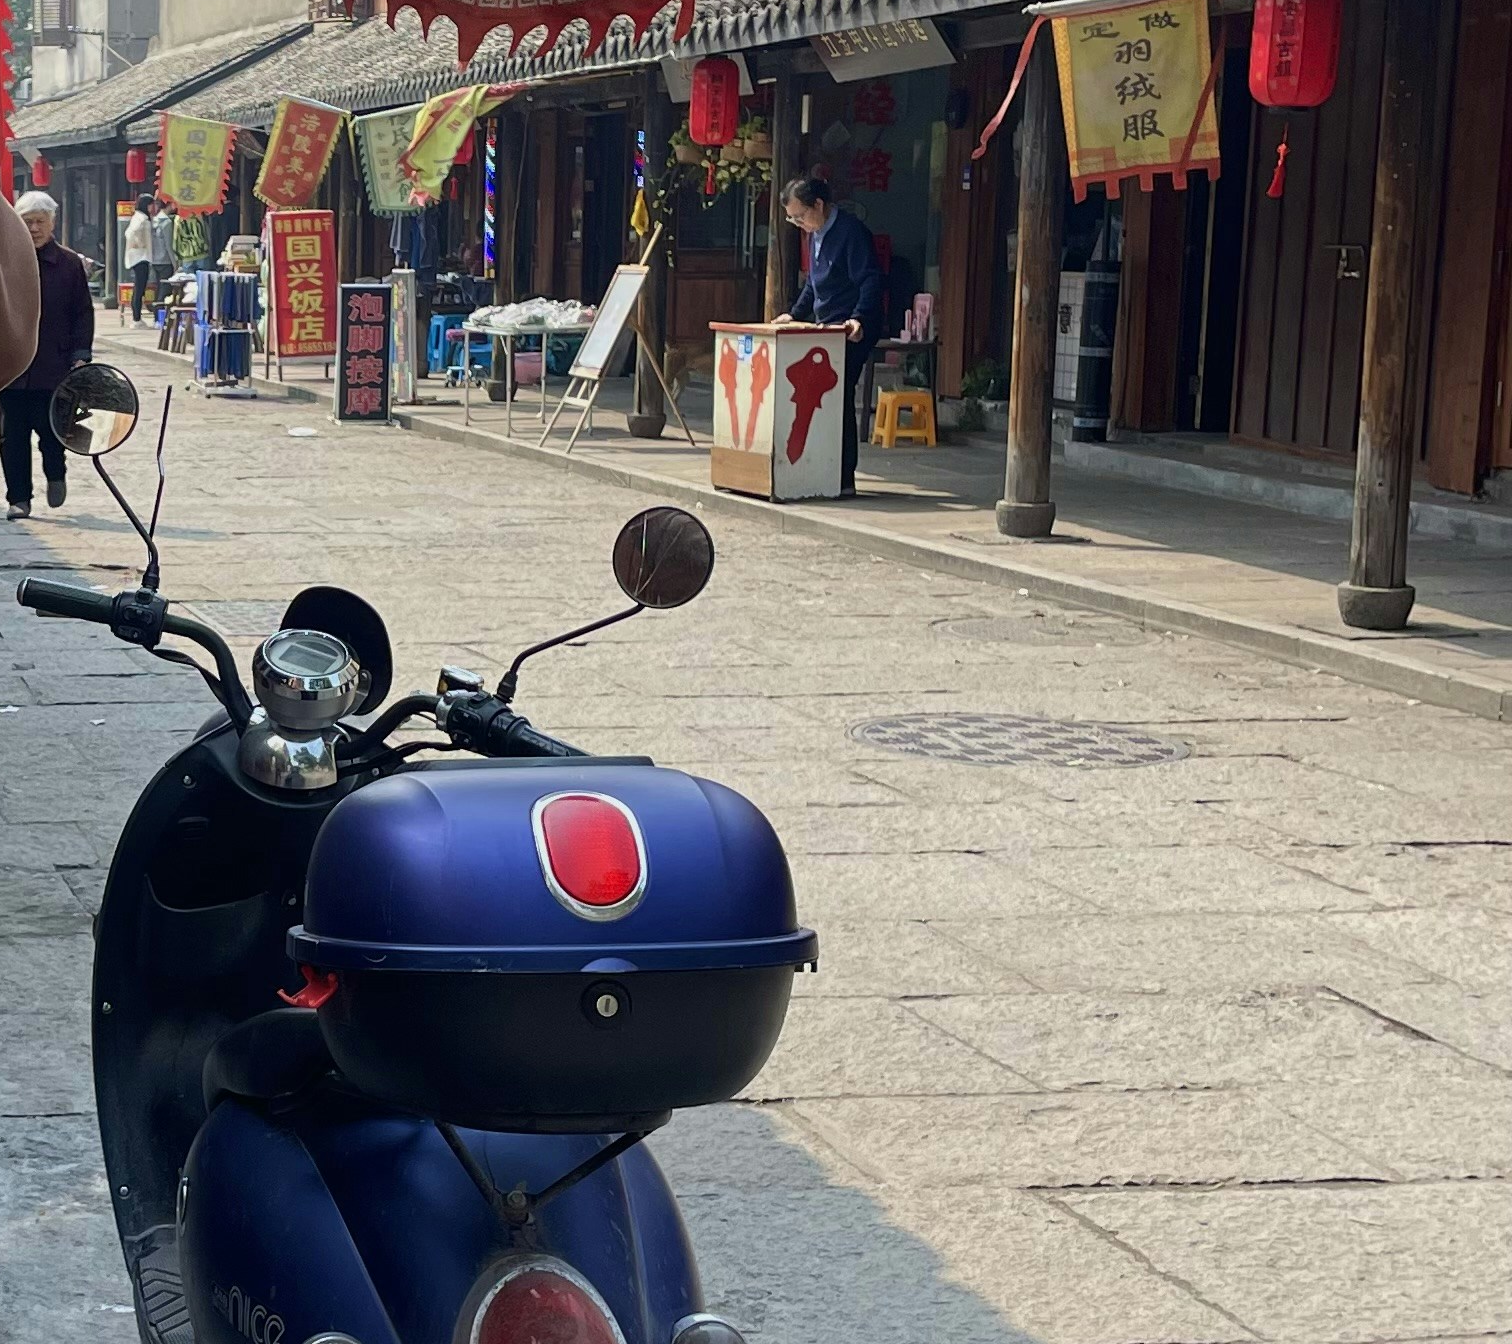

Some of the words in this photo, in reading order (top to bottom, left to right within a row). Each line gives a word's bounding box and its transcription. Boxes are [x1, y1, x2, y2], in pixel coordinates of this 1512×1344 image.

[1080, 10, 1180, 42] 定做
[1114, 38, 1165, 142] 羽绒服
[286, 235, 326, 342] 国兴饭店
[345, 292, 386, 416] 泡脚按摩
